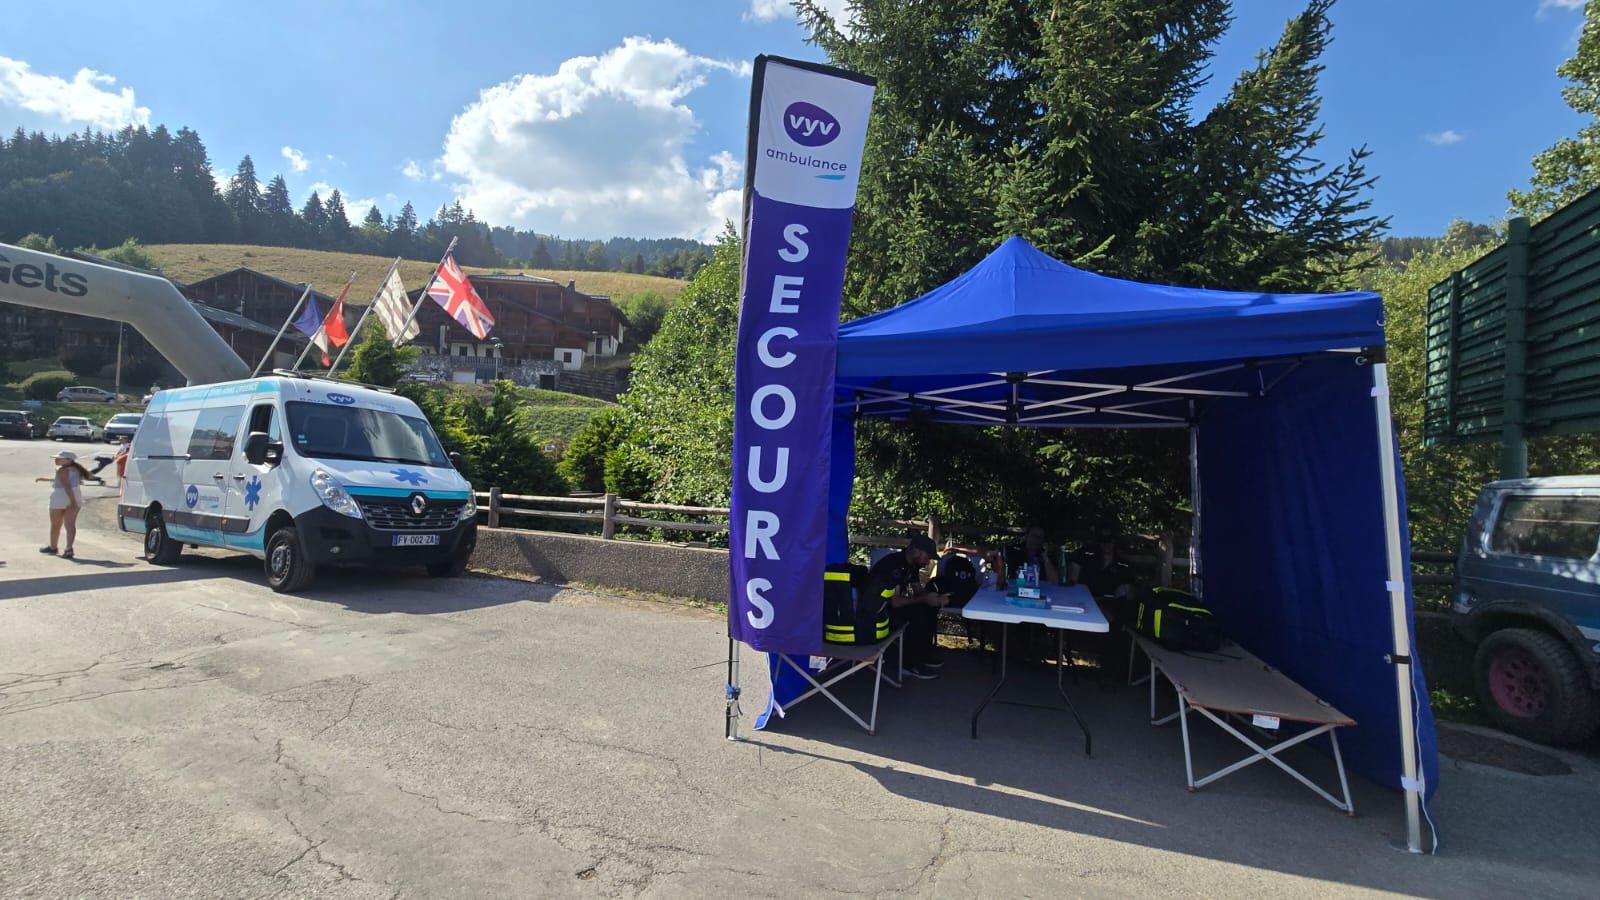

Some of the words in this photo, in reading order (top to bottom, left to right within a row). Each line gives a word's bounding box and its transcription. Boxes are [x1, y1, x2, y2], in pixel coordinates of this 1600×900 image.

[789, 114, 835, 136] vyv
[766, 148, 848, 171] ambulance
[745, 223, 809, 630] SECOURS
